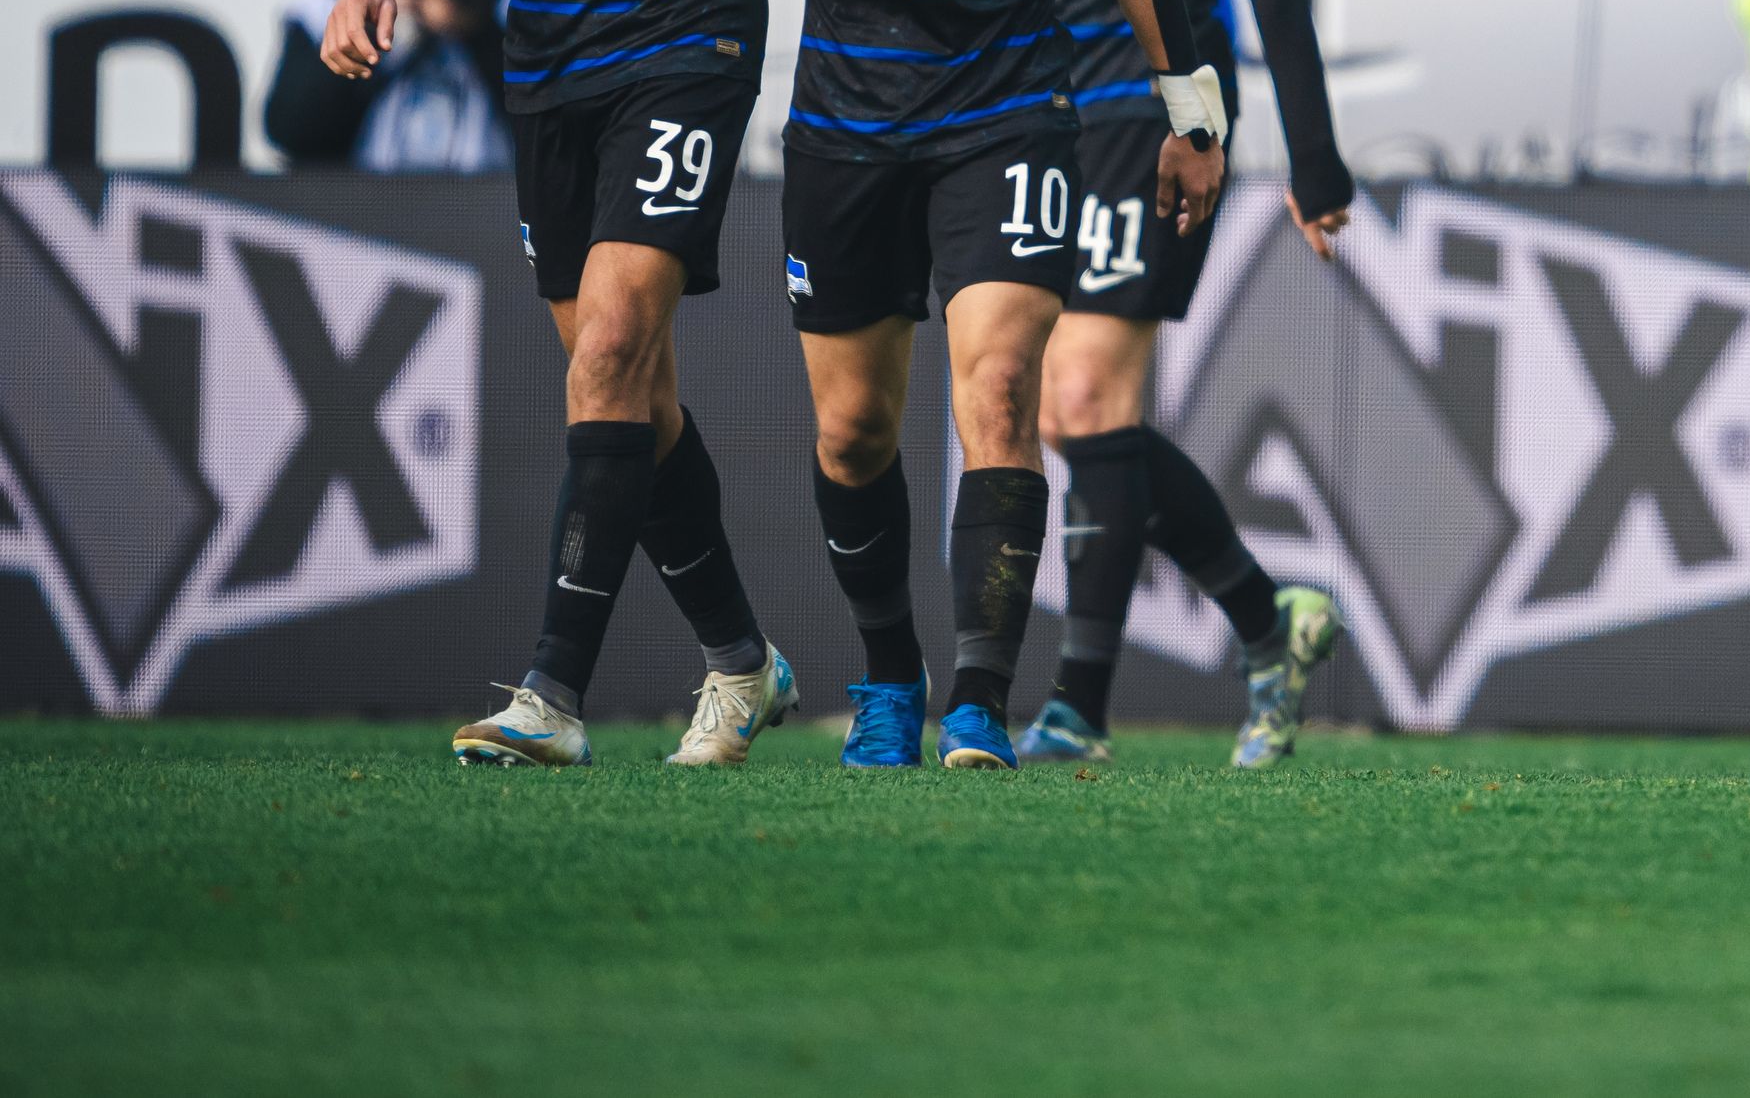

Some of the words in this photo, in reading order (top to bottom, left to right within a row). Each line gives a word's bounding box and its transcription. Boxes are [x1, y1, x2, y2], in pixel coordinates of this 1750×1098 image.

[635, 119, 713, 201] 39
[1000, 162, 1068, 239] 10
[1077, 193, 1146, 275] 41
